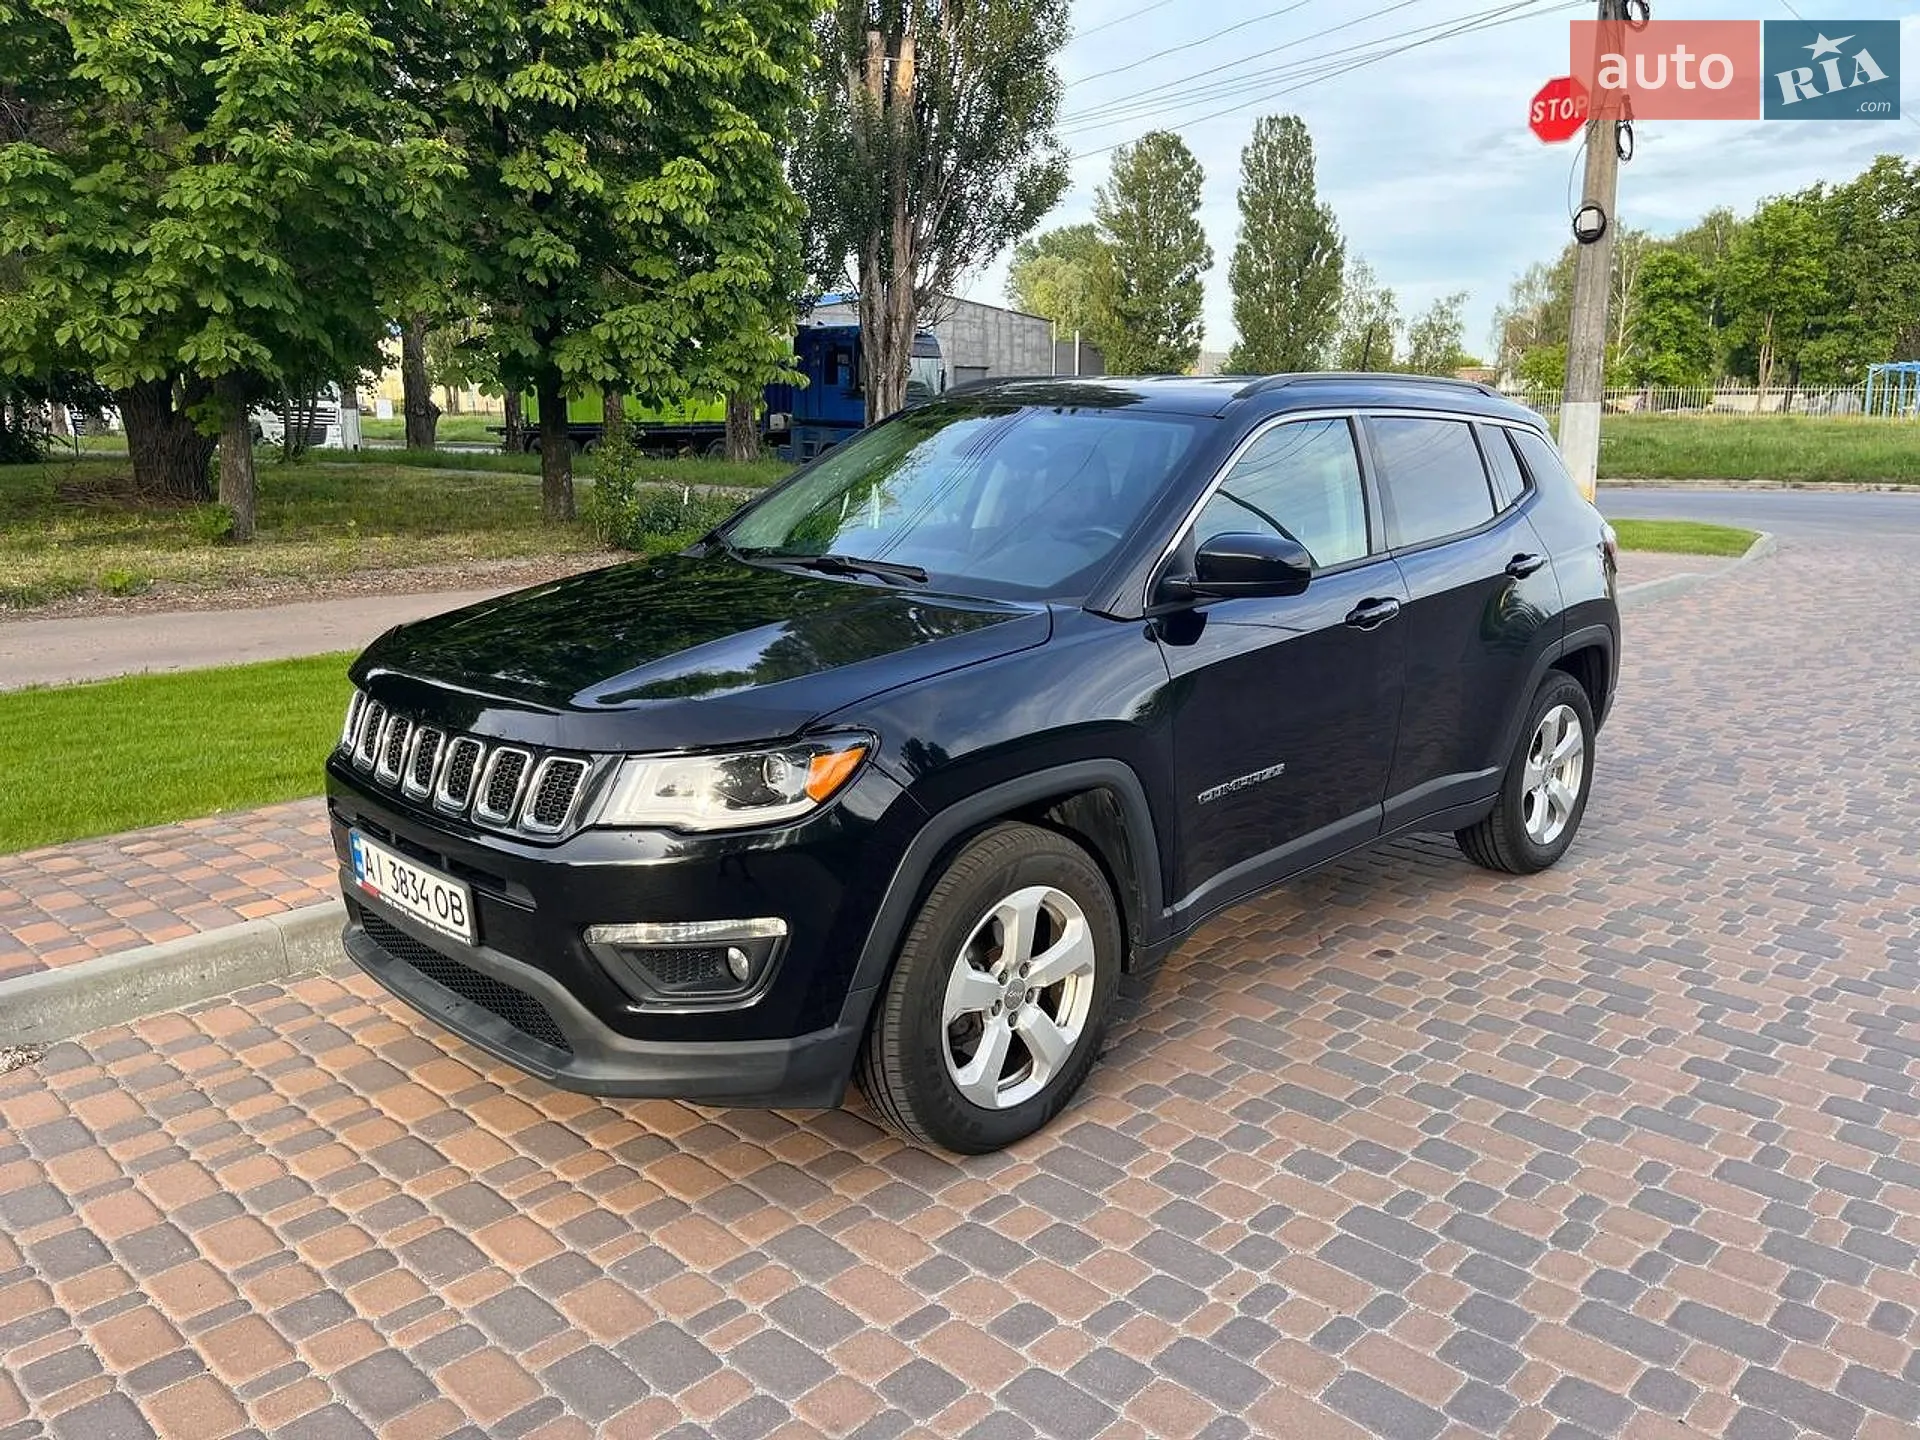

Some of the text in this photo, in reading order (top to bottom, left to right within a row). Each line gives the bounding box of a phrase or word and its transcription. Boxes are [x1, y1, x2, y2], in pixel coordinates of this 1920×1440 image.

[1531, 95, 1588, 124] STOP
[365, 847, 384, 888] AI
[389, 860, 431, 913] 3834
[434, 884, 465, 927] OB
